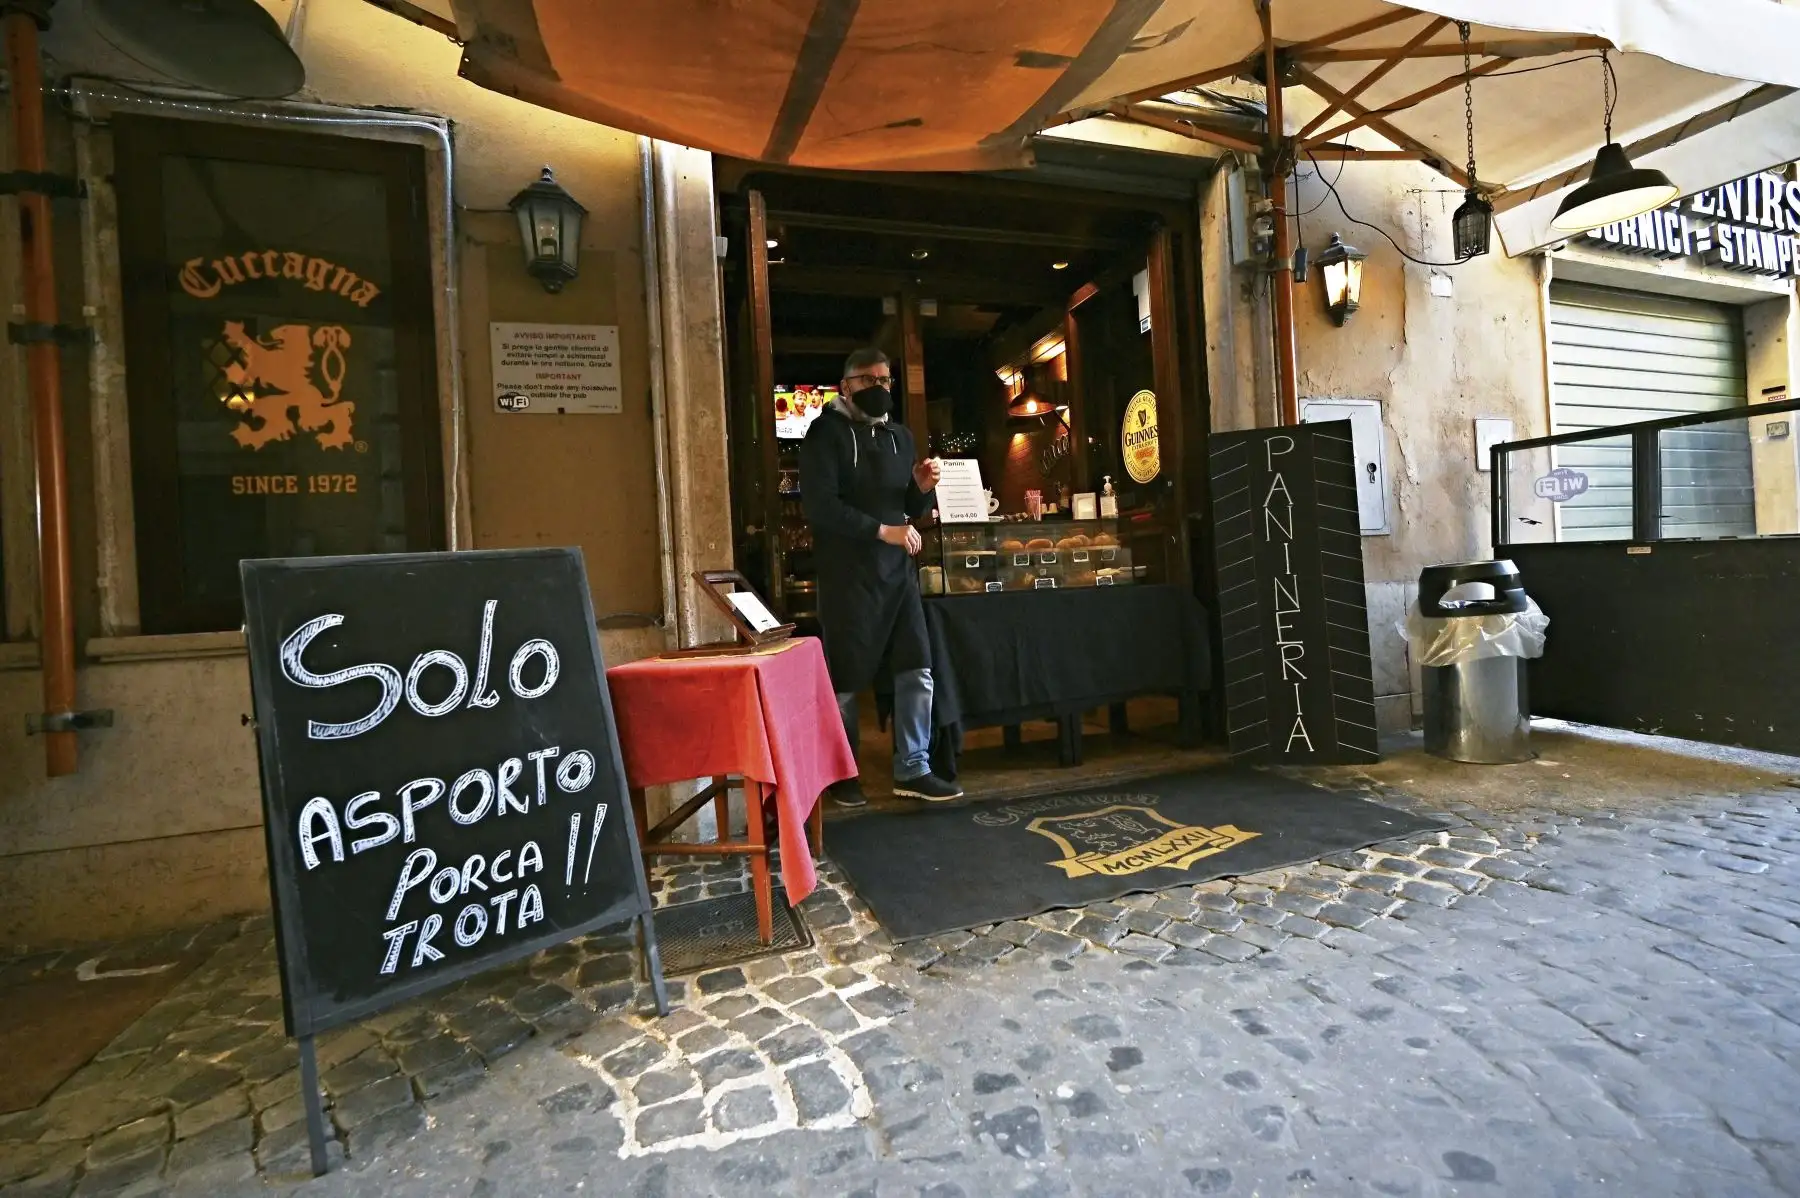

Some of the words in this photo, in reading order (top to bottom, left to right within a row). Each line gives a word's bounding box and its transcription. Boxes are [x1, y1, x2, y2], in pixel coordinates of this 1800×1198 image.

[1671, 173, 1800, 234] ENIRS
[514, 332, 544, 340] AVVISO
[546, 333, 597, 341] IMPORTANTE
[511, 344, 534, 352] prega
[543, 344, 568, 352] gentile
[534, 352, 558, 360] rumori
[496, 382, 522, 390] Please
[573, 392, 587, 400] pub
[1125, 425, 1158, 447] GUINNES
[232, 475, 299, 494] SINCE
[308, 475, 358, 493] 1972
[1263, 435, 1315, 753] PANINERIA
[299, 745, 596, 870] ASPORTO
[1102, 829, 1213, 874] MCMLXXII
[387, 841, 544, 921] PORCA
[380, 884, 544, 975] TROTA
